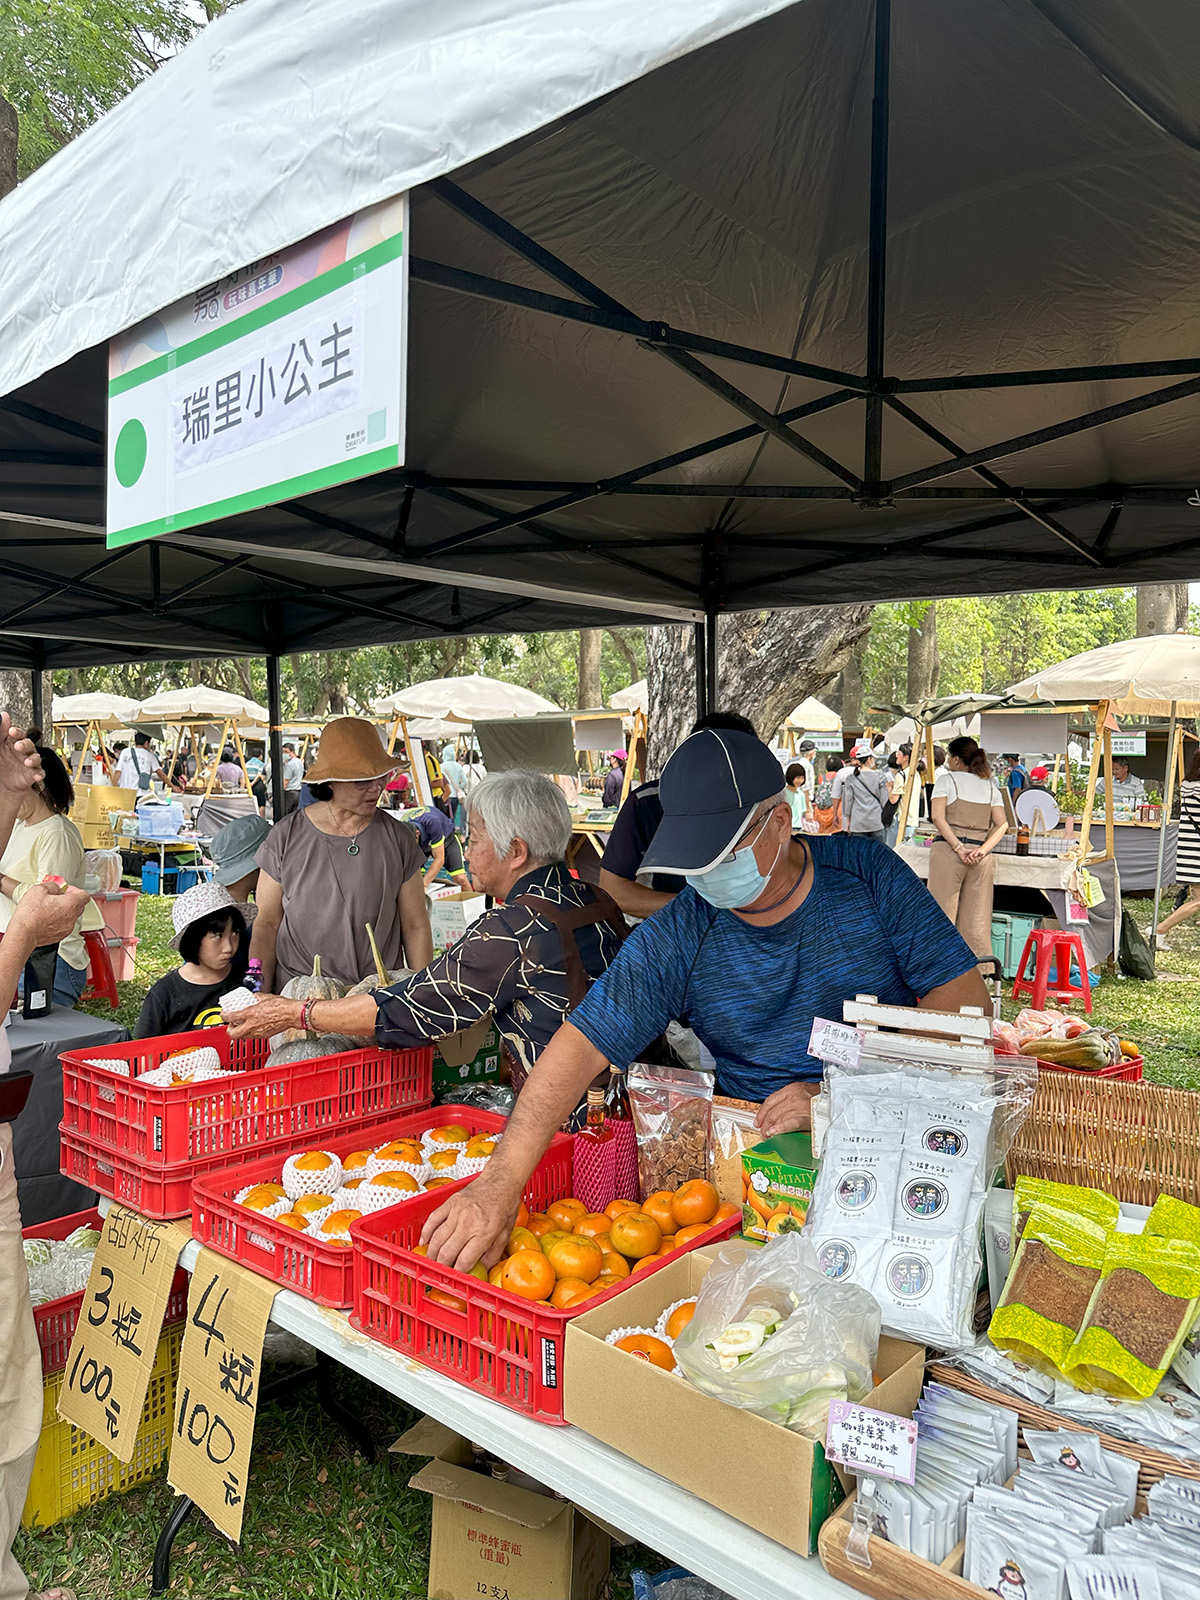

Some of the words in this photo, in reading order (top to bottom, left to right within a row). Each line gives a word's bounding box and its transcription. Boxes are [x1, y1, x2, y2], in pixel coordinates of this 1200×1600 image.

[182, 321, 354, 445] 瑞里小公主
[69, 1345, 121, 1440] 100元
[178, 1387, 241, 1506] 100元
[467, 1527, 522, 1557] 標準蜂蜜瓶
[479, 1547, 510, 1567] (重量)
[476, 1581, 488, 1595] 12
[489, 1585, 510, 1600] 支入
